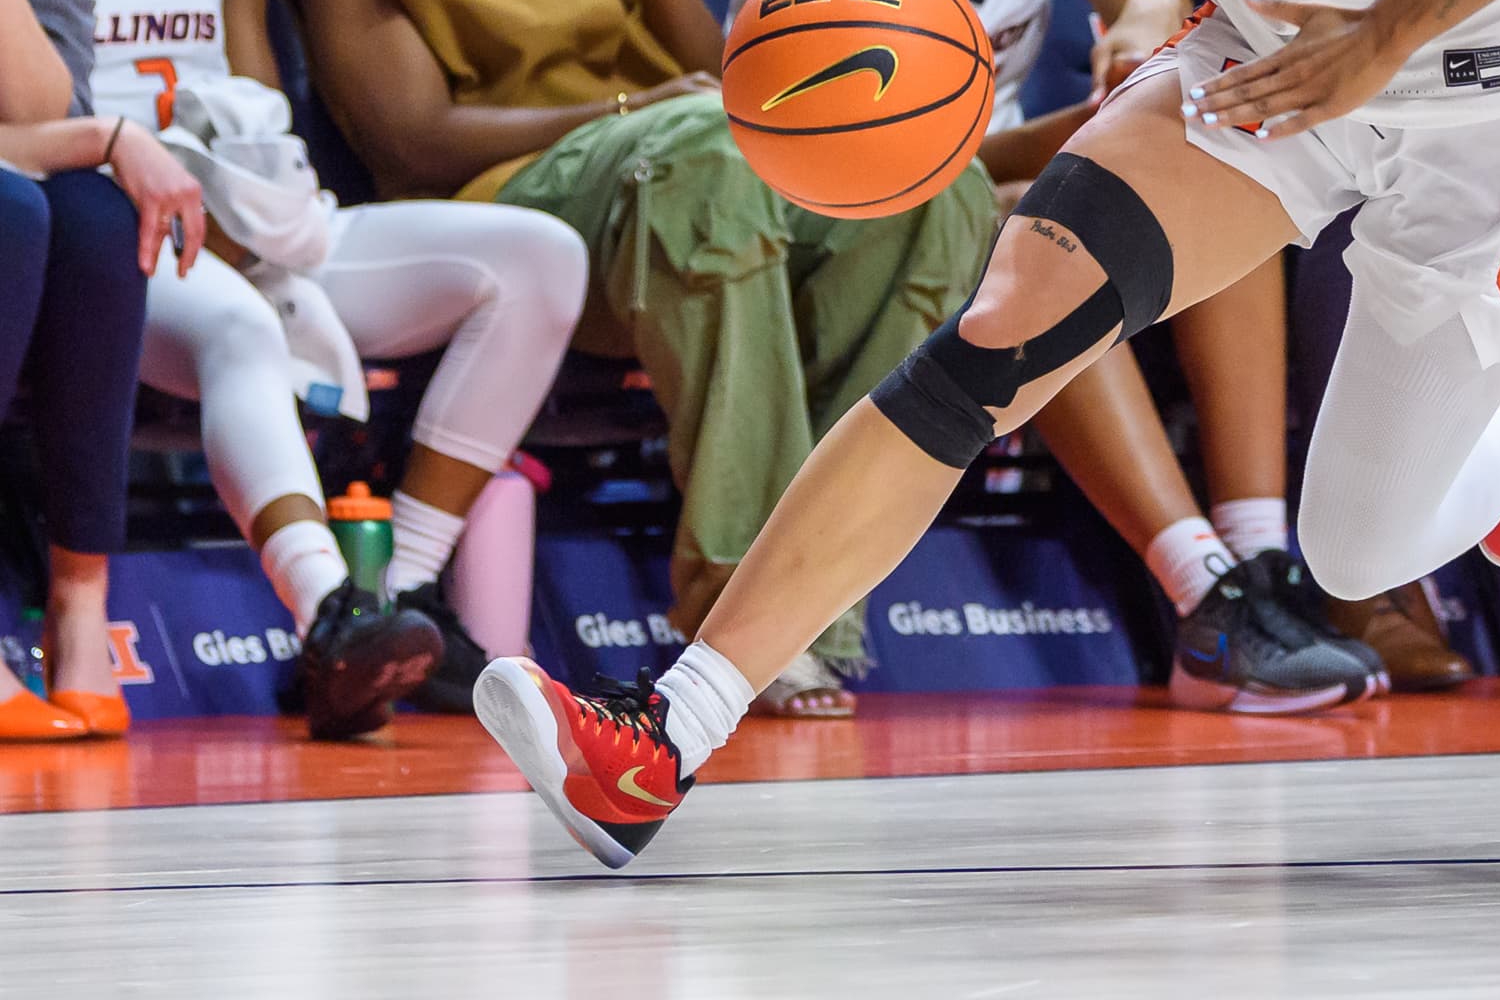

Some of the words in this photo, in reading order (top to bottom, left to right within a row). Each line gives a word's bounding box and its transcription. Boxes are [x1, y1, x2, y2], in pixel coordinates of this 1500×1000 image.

[575, 612, 648, 648] Gies
[888, 600, 963, 635] Gies
[963, 600, 1112, 635] Business
[193, 629, 267, 666] Gies
